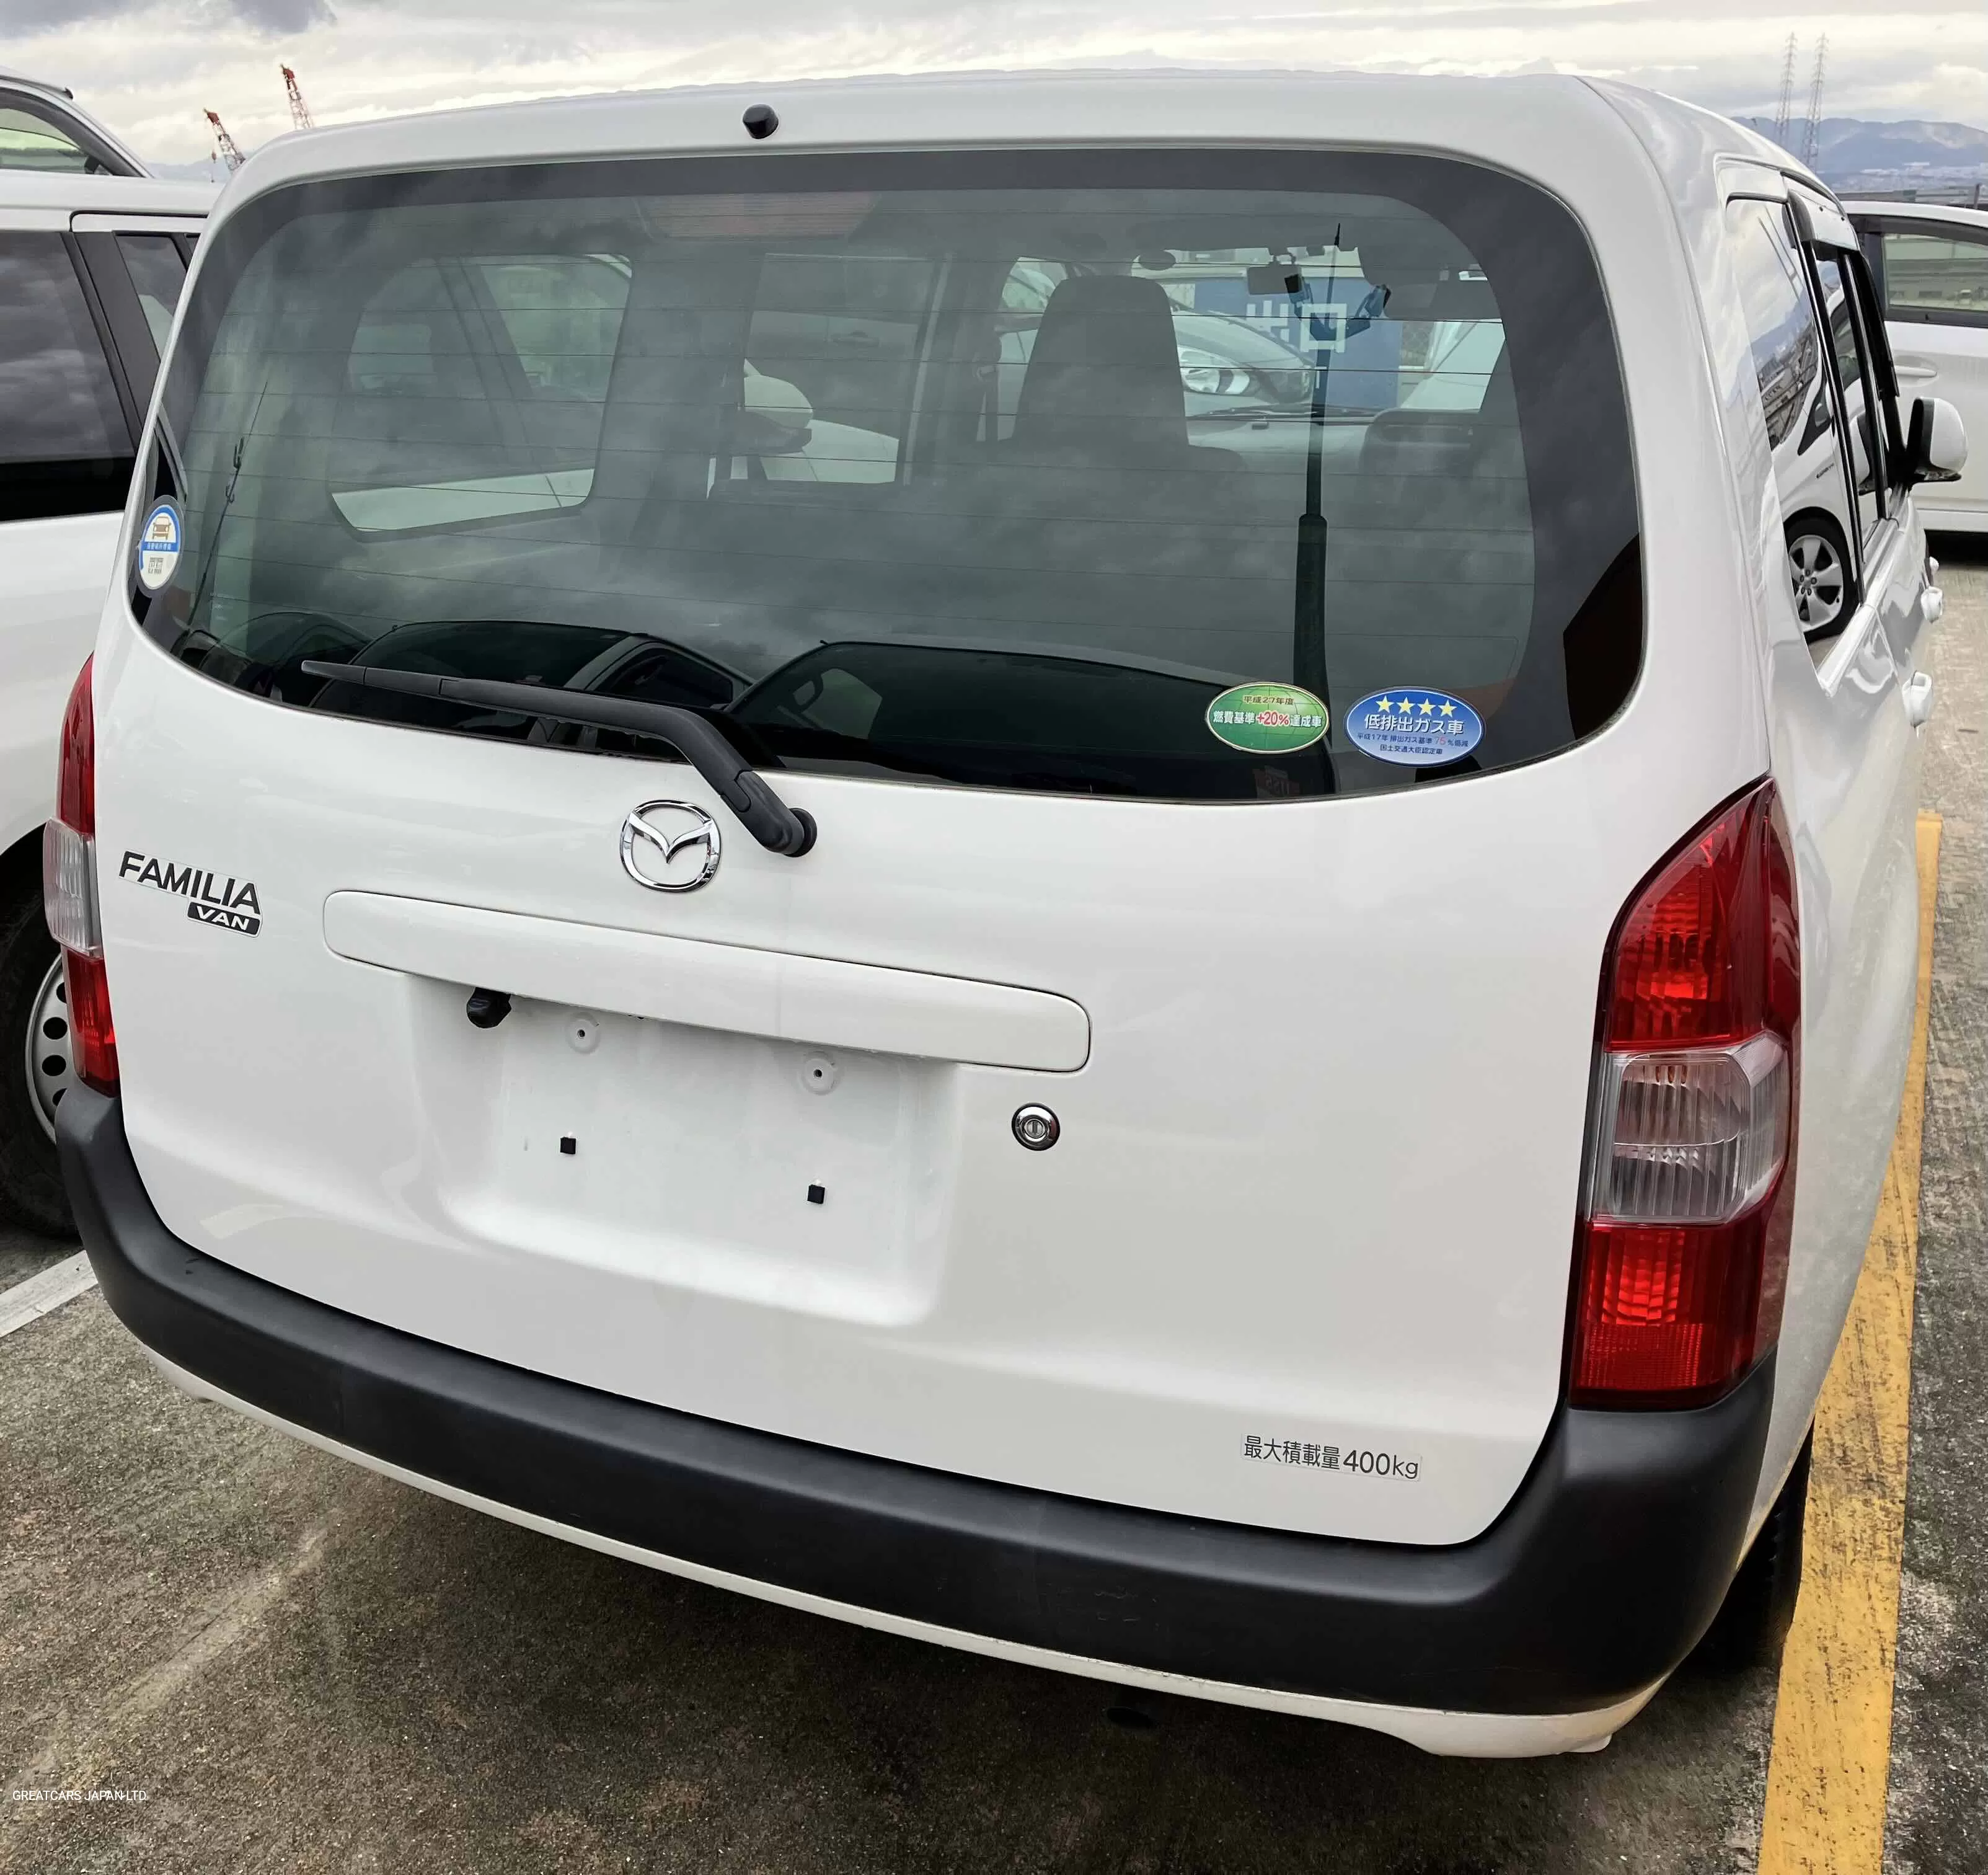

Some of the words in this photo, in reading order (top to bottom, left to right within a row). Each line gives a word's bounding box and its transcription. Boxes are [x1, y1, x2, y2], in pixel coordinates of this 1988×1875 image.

[1243, 695, 1294, 706] 平成27年度
[1364, 714, 1465, 736] 低排出ガス車
[118, 850, 261, 915] FAMILIA
[196, 905, 250, 931] VAN
